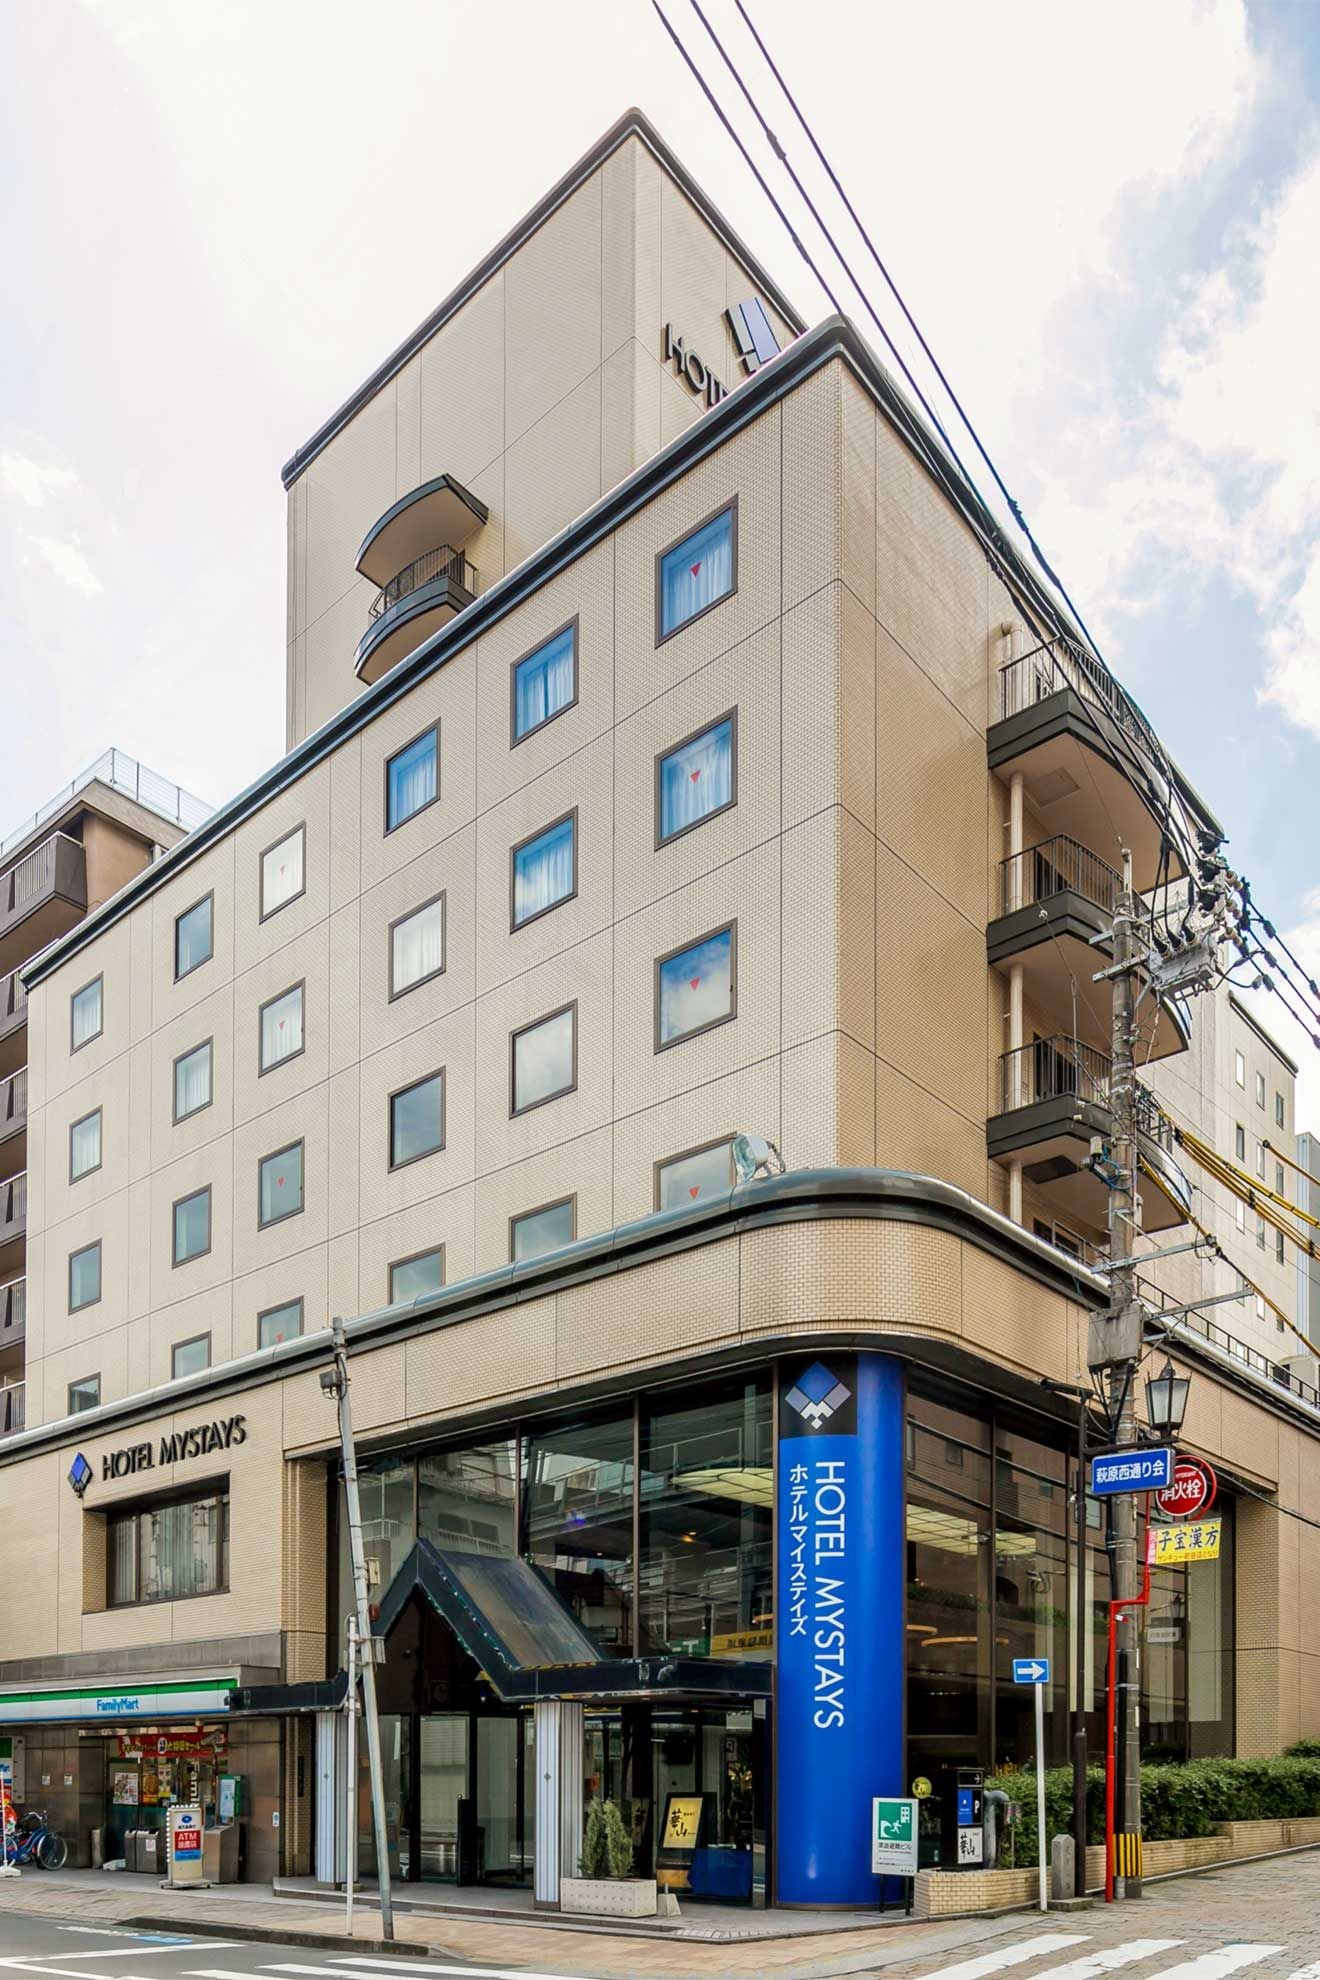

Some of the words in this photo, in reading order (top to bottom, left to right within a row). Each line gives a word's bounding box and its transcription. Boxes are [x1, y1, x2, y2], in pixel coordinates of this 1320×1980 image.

[102, 1441, 155, 1481] HOTEL
[159, 1414, 247, 1466] MYSTAYS
[1161, 1479, 1202, 1502] 消火栓
[815, 1461, 846, 1566] HOTEL
[789, 1463, 809, 1636] ホテルマイステイズ
[1158, 1526, 1219, 1552] 子宝漢方
[813, 1576, 845, 1729] MYSTAYS
[96, 1698, 139, 1713] FamilyMart
[974, 1800, 981, 1814] P
[177, 1832, 198, 1841] ATM
